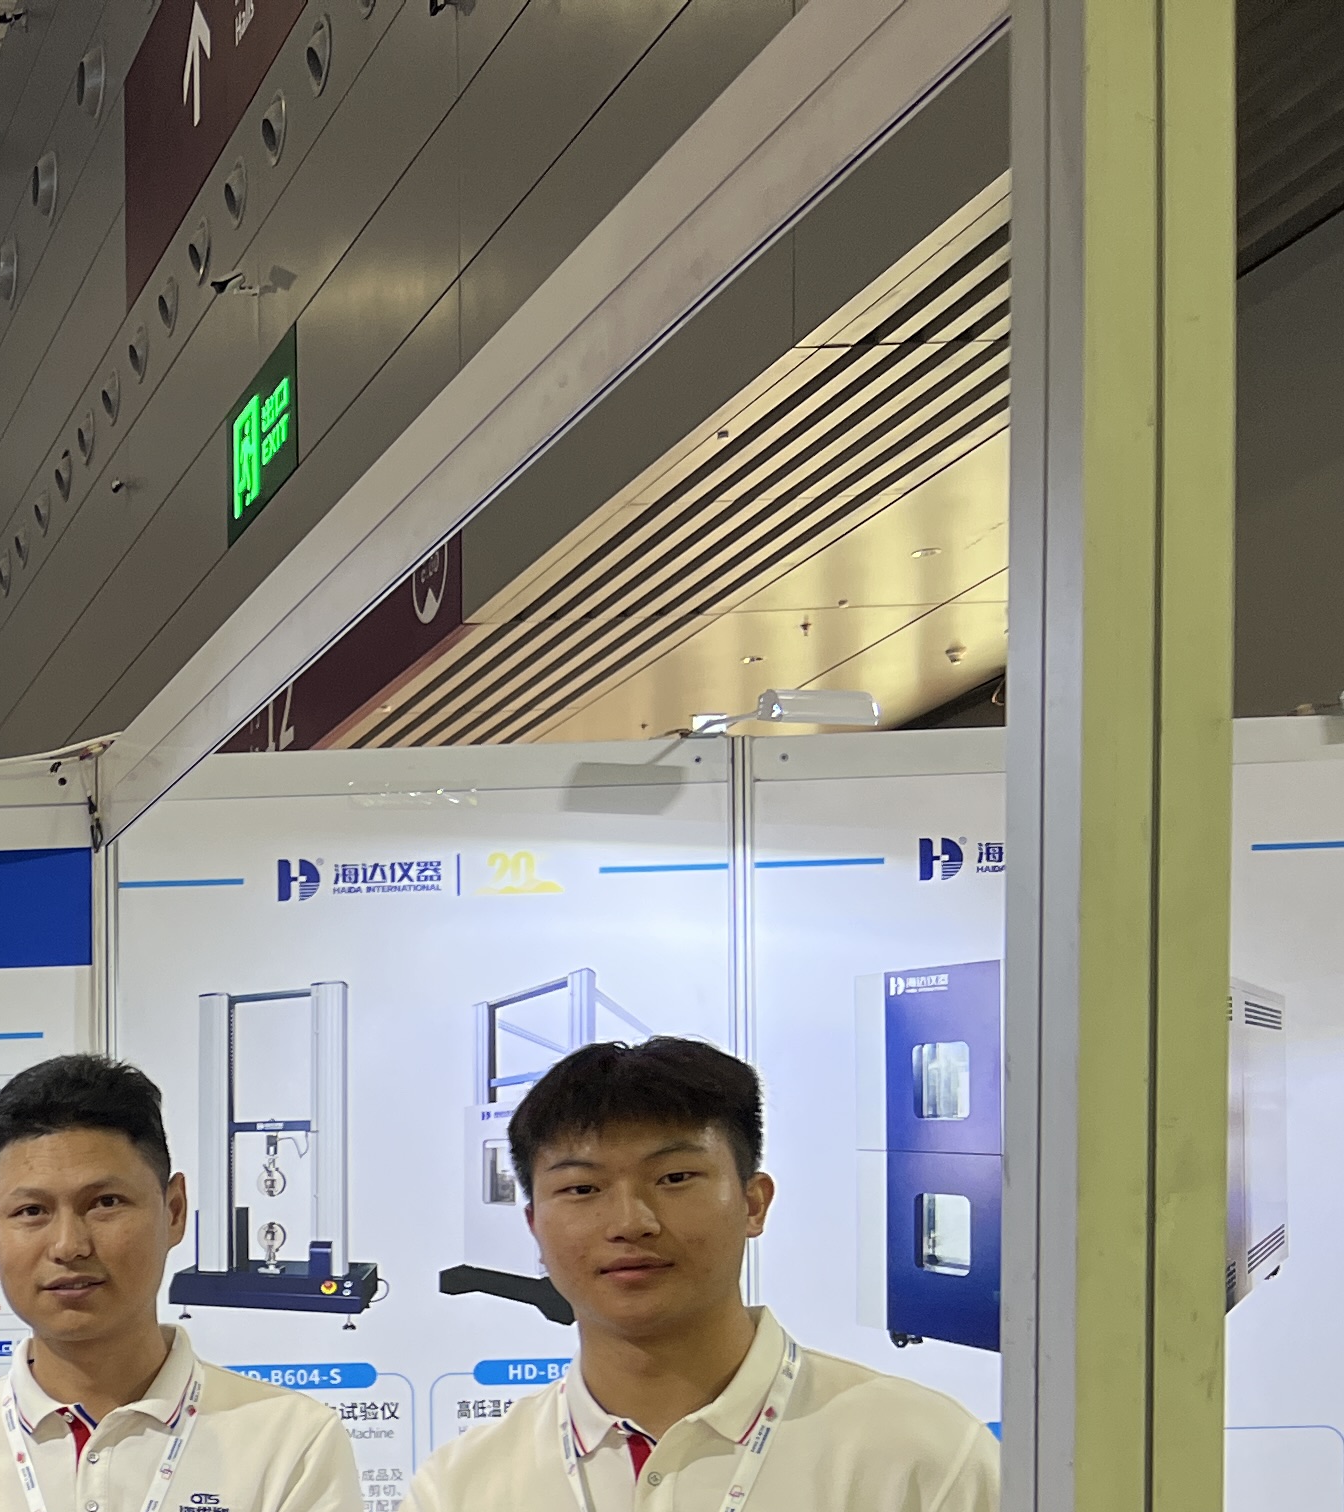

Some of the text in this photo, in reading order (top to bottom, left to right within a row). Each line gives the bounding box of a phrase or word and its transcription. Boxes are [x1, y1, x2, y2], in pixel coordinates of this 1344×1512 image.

[261, 377, 290, 433] 出口
[261, 413, 290, 466] EXIT
[333, 861, 442, 885] 海达仪器
[333, 883, 442, 895] HAIDA INTERNATIONAL
